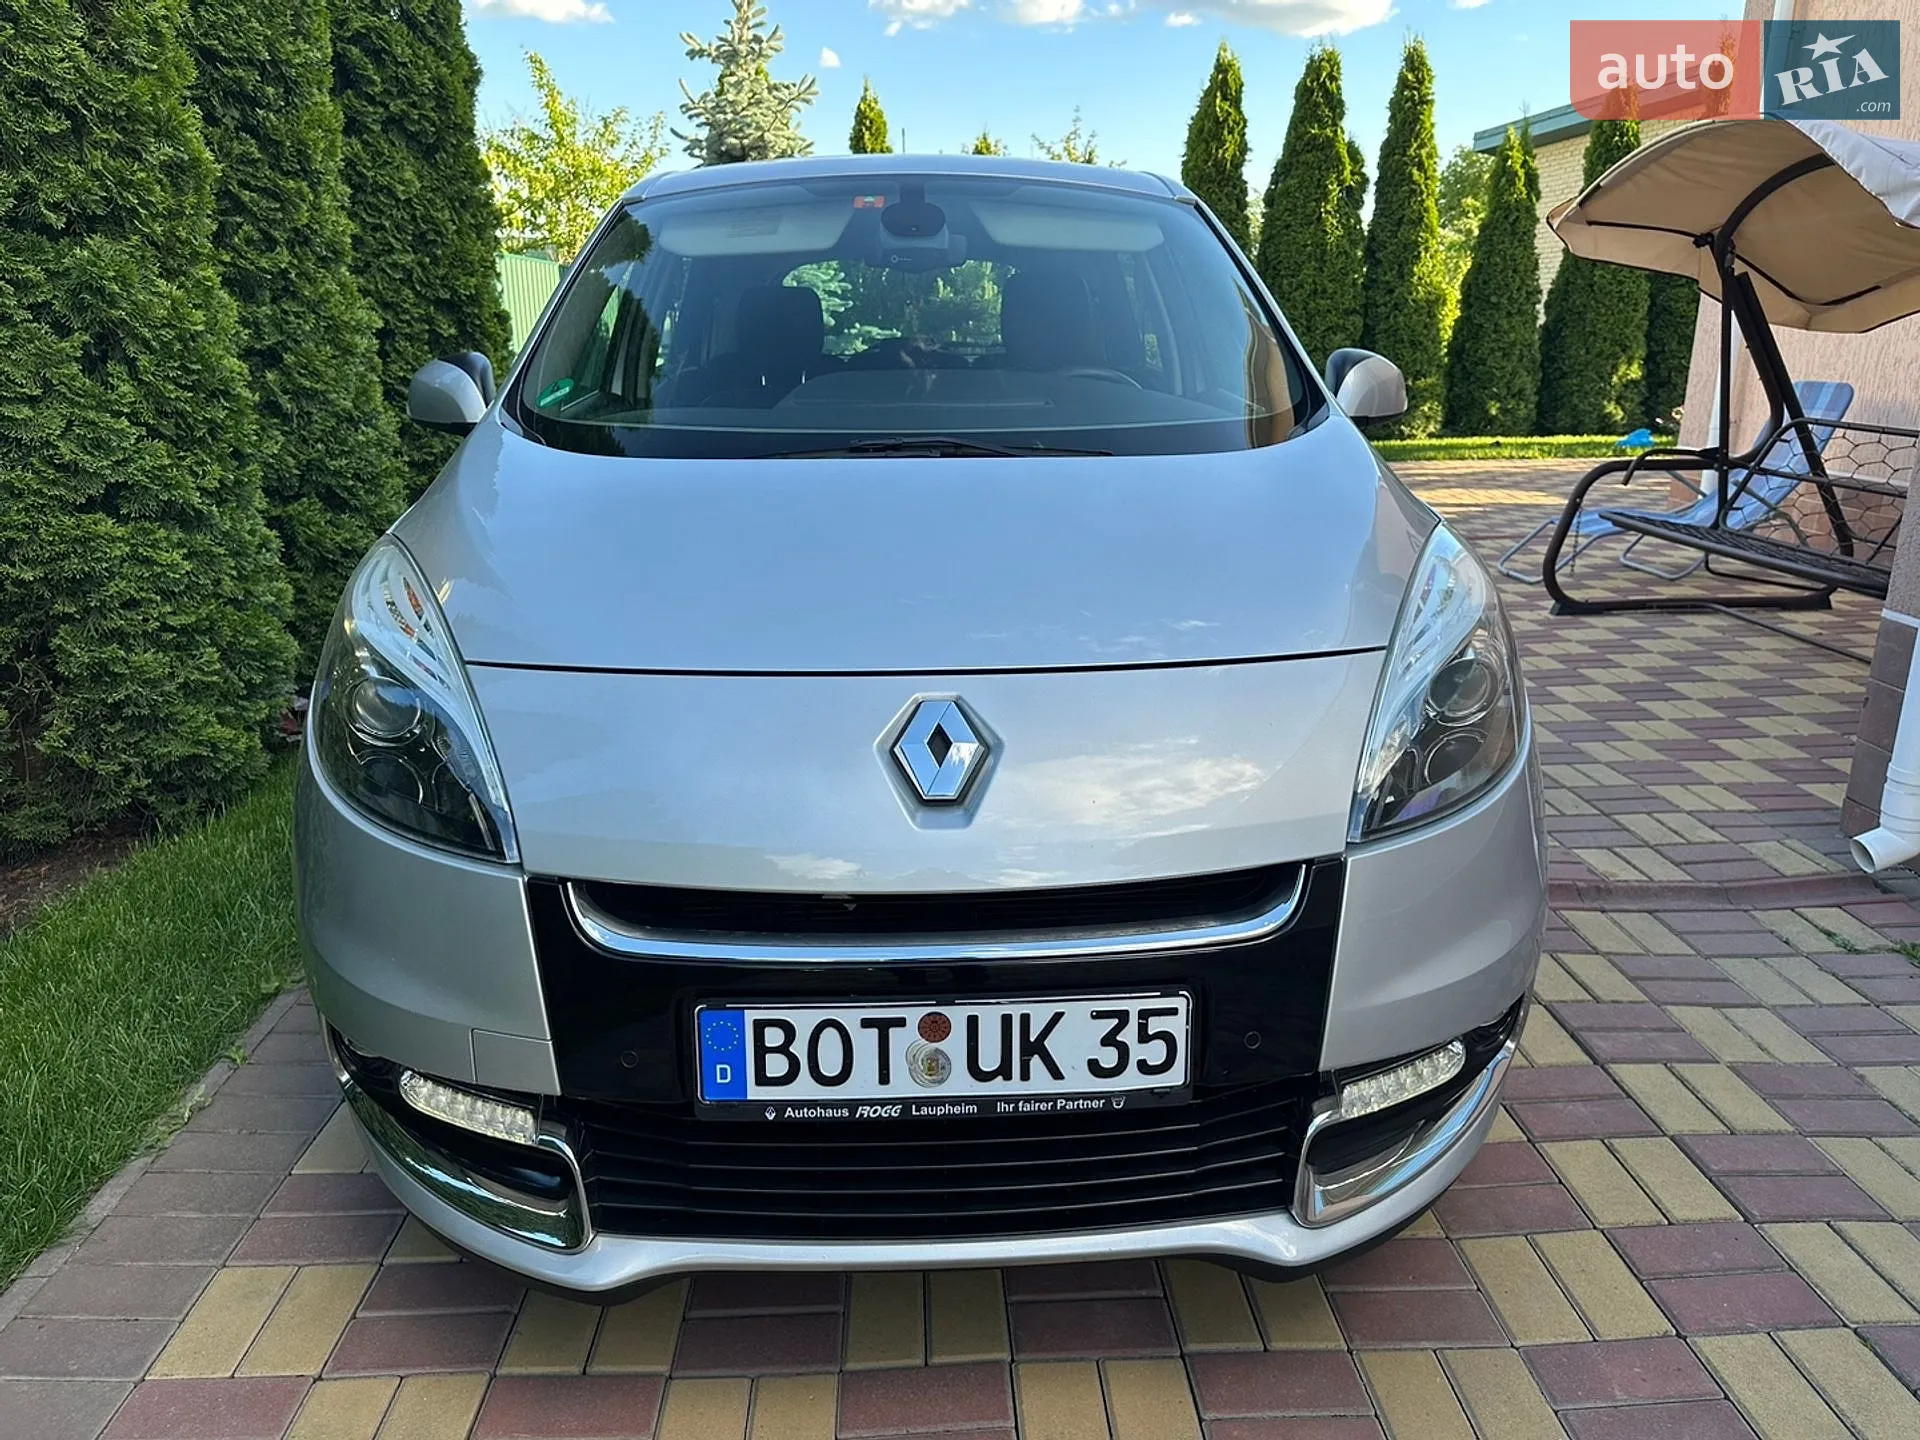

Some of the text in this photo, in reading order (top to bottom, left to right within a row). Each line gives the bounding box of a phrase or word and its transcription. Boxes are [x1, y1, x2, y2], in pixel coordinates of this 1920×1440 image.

[753, 1007, 1179, 1087] BOT UK 35
[716, 1065, 731, 1084] D
[784, 1106, 850, 1119] Autohaus
[911, 1103, 978, 1117] Laupheim
[996, 1098, 1106, 1113] Ihr fairer Partner
